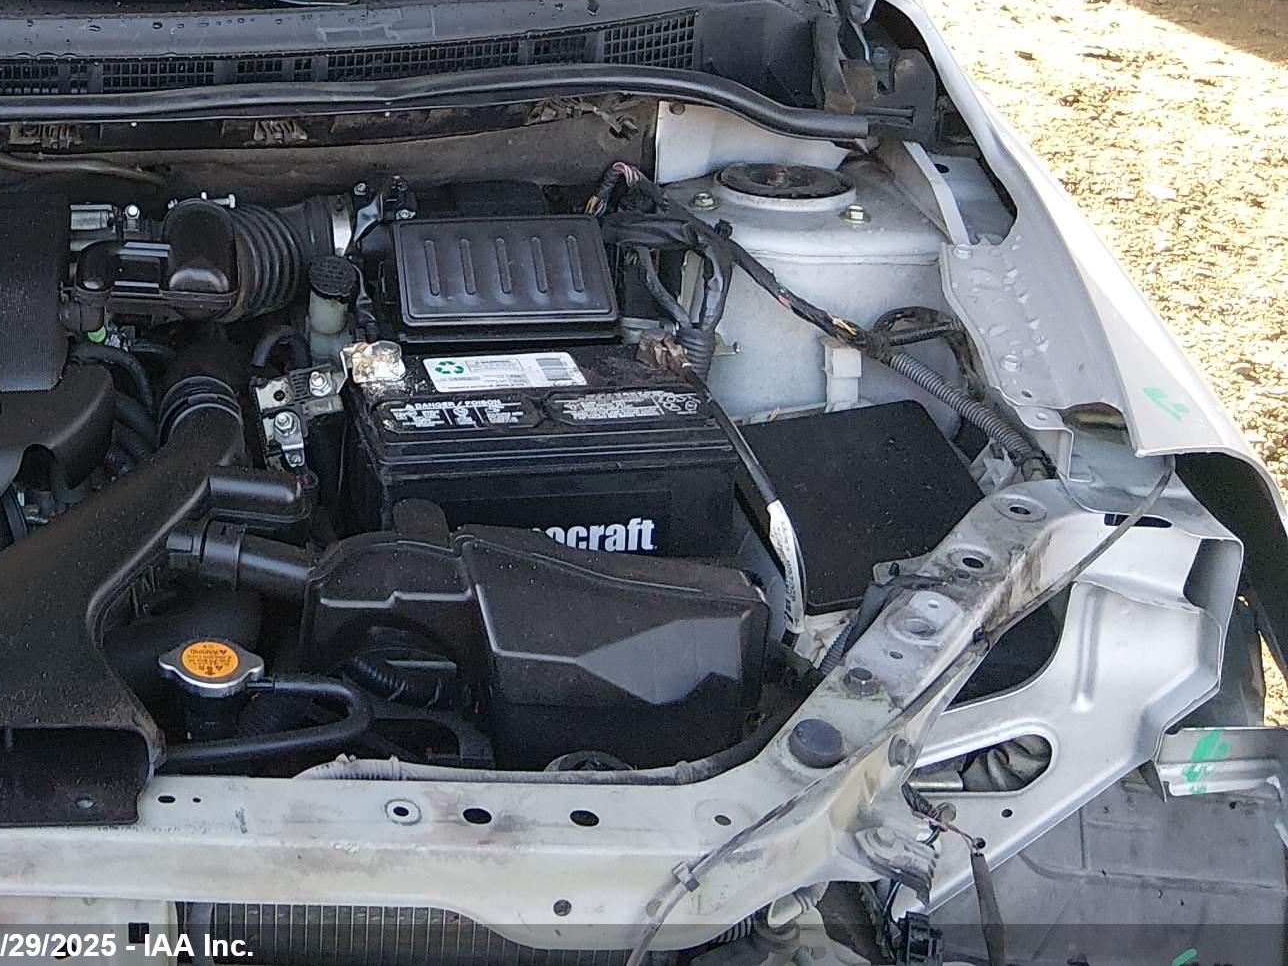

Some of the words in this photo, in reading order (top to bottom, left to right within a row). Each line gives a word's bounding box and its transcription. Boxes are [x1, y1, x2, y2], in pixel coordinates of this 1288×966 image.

[414, 401, 456, 410] DANGER
[464, 399, 502, 408] POISON
[531, 517, 655, 552] ocraft
